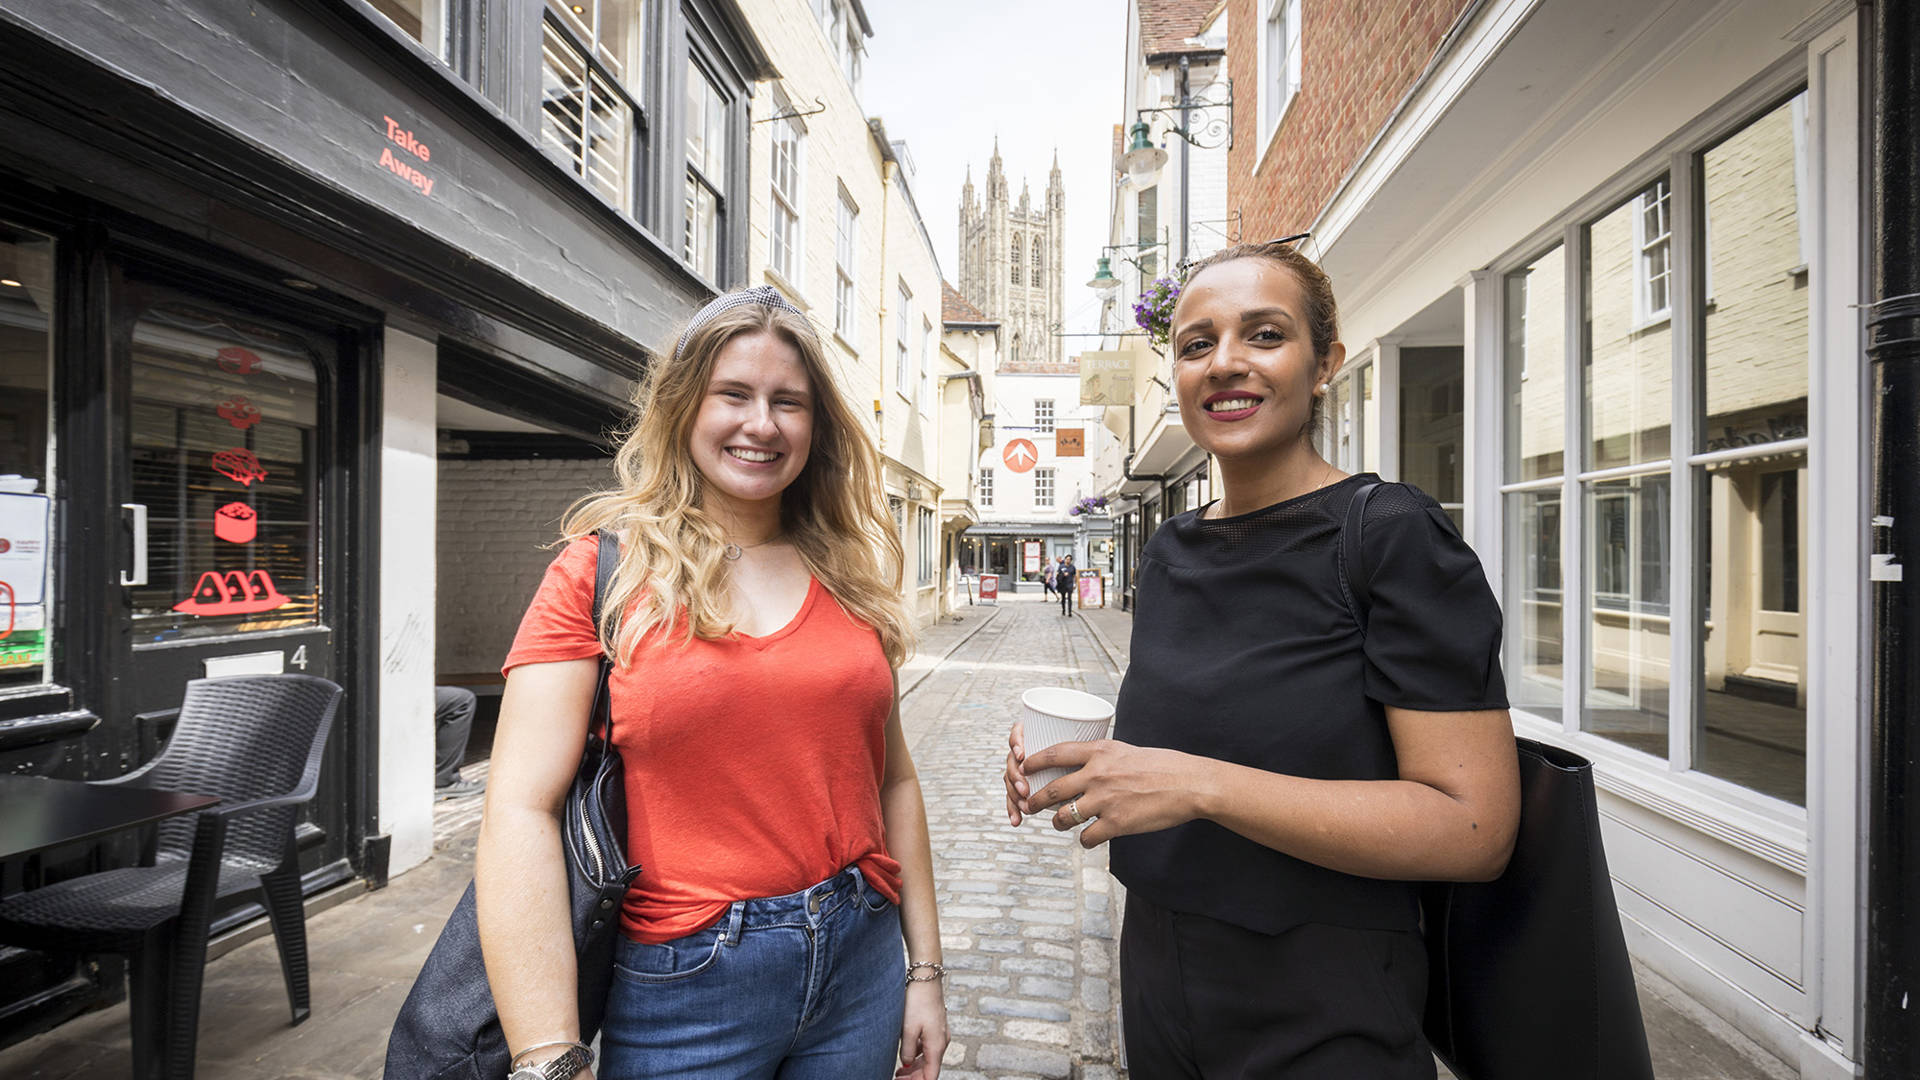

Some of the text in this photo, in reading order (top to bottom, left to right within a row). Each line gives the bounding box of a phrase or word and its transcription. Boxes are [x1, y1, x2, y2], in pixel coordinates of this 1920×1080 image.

[384, 115, 430, 162] Take
[379, 147, 434, 196] Away
[1086, 359, 1130, 369] TERRACE
[290, 645, 308, 670] 4
